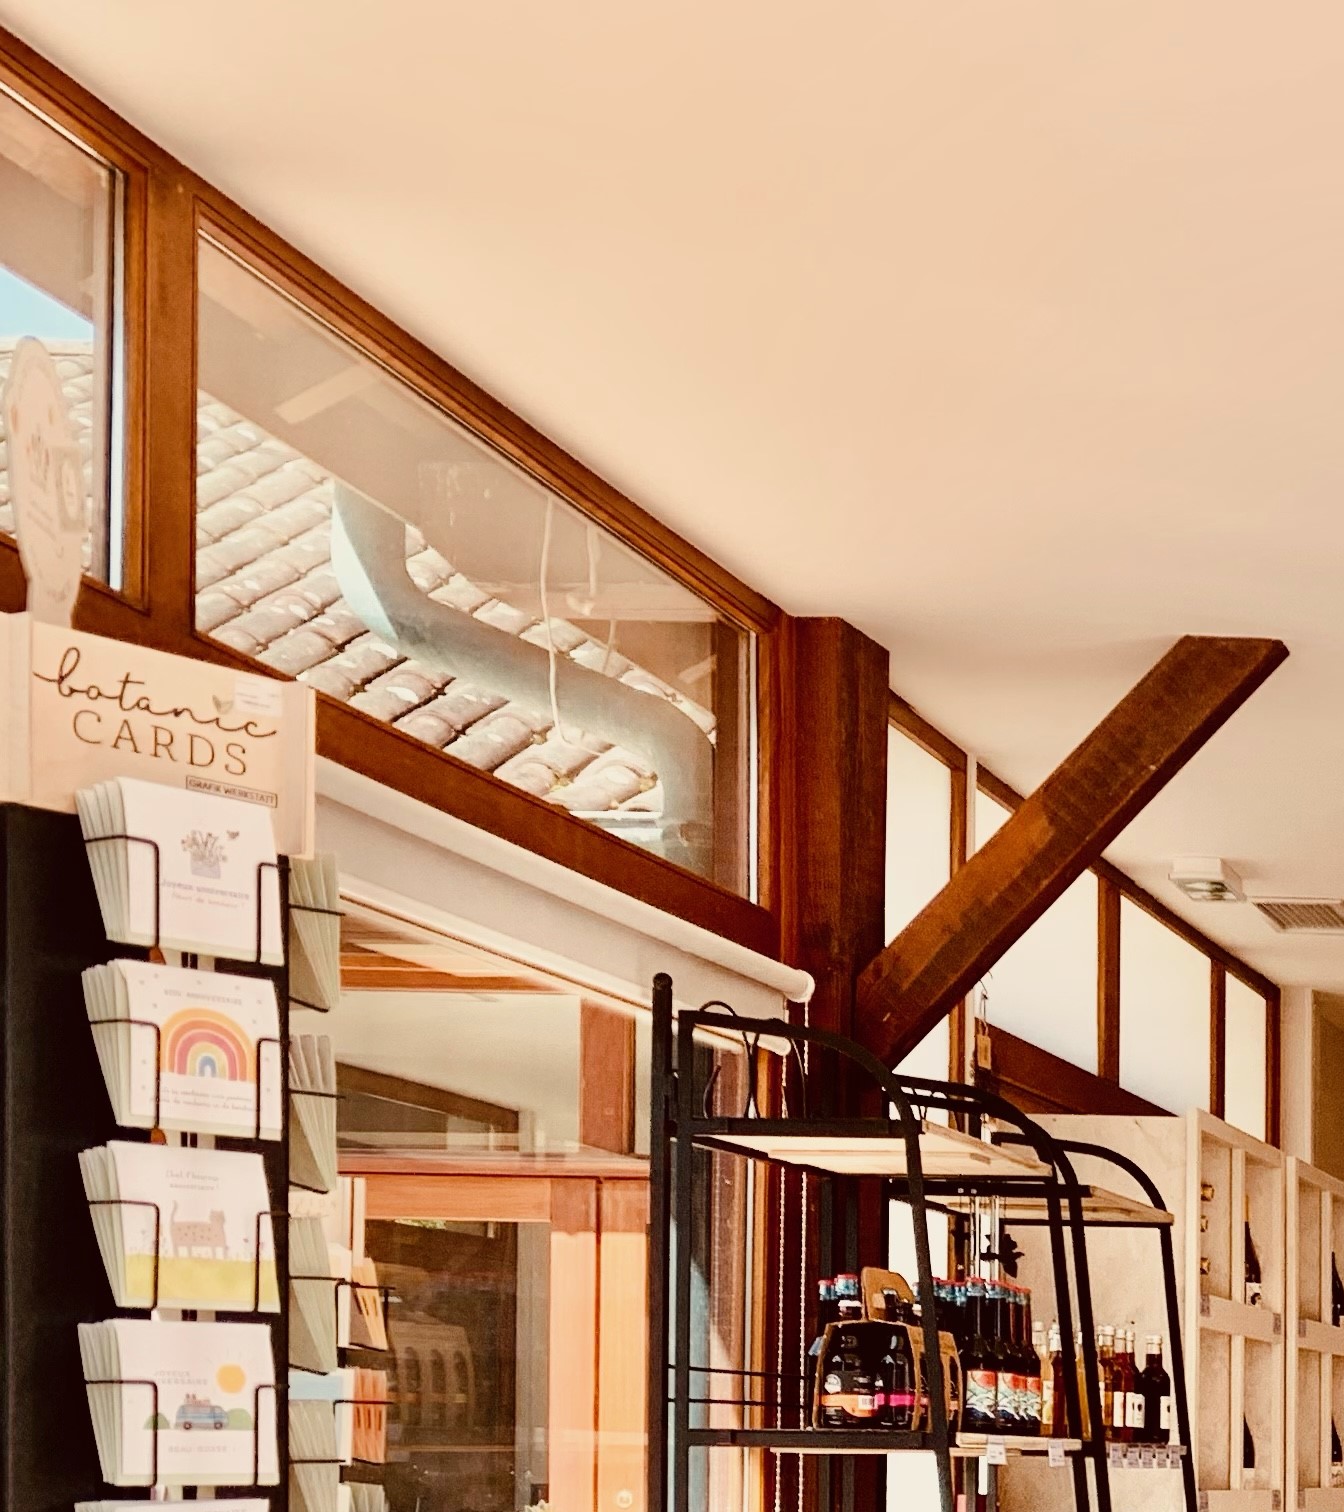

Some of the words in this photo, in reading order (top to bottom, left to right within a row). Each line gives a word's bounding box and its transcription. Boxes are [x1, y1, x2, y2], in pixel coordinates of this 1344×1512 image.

[32, 646, 278, 737] botanic
[72, 709, 248, 776] CARDS
[188, 779, 221, 793] GRAFIK
[223, 785, 275, 804] WERKSTATT
